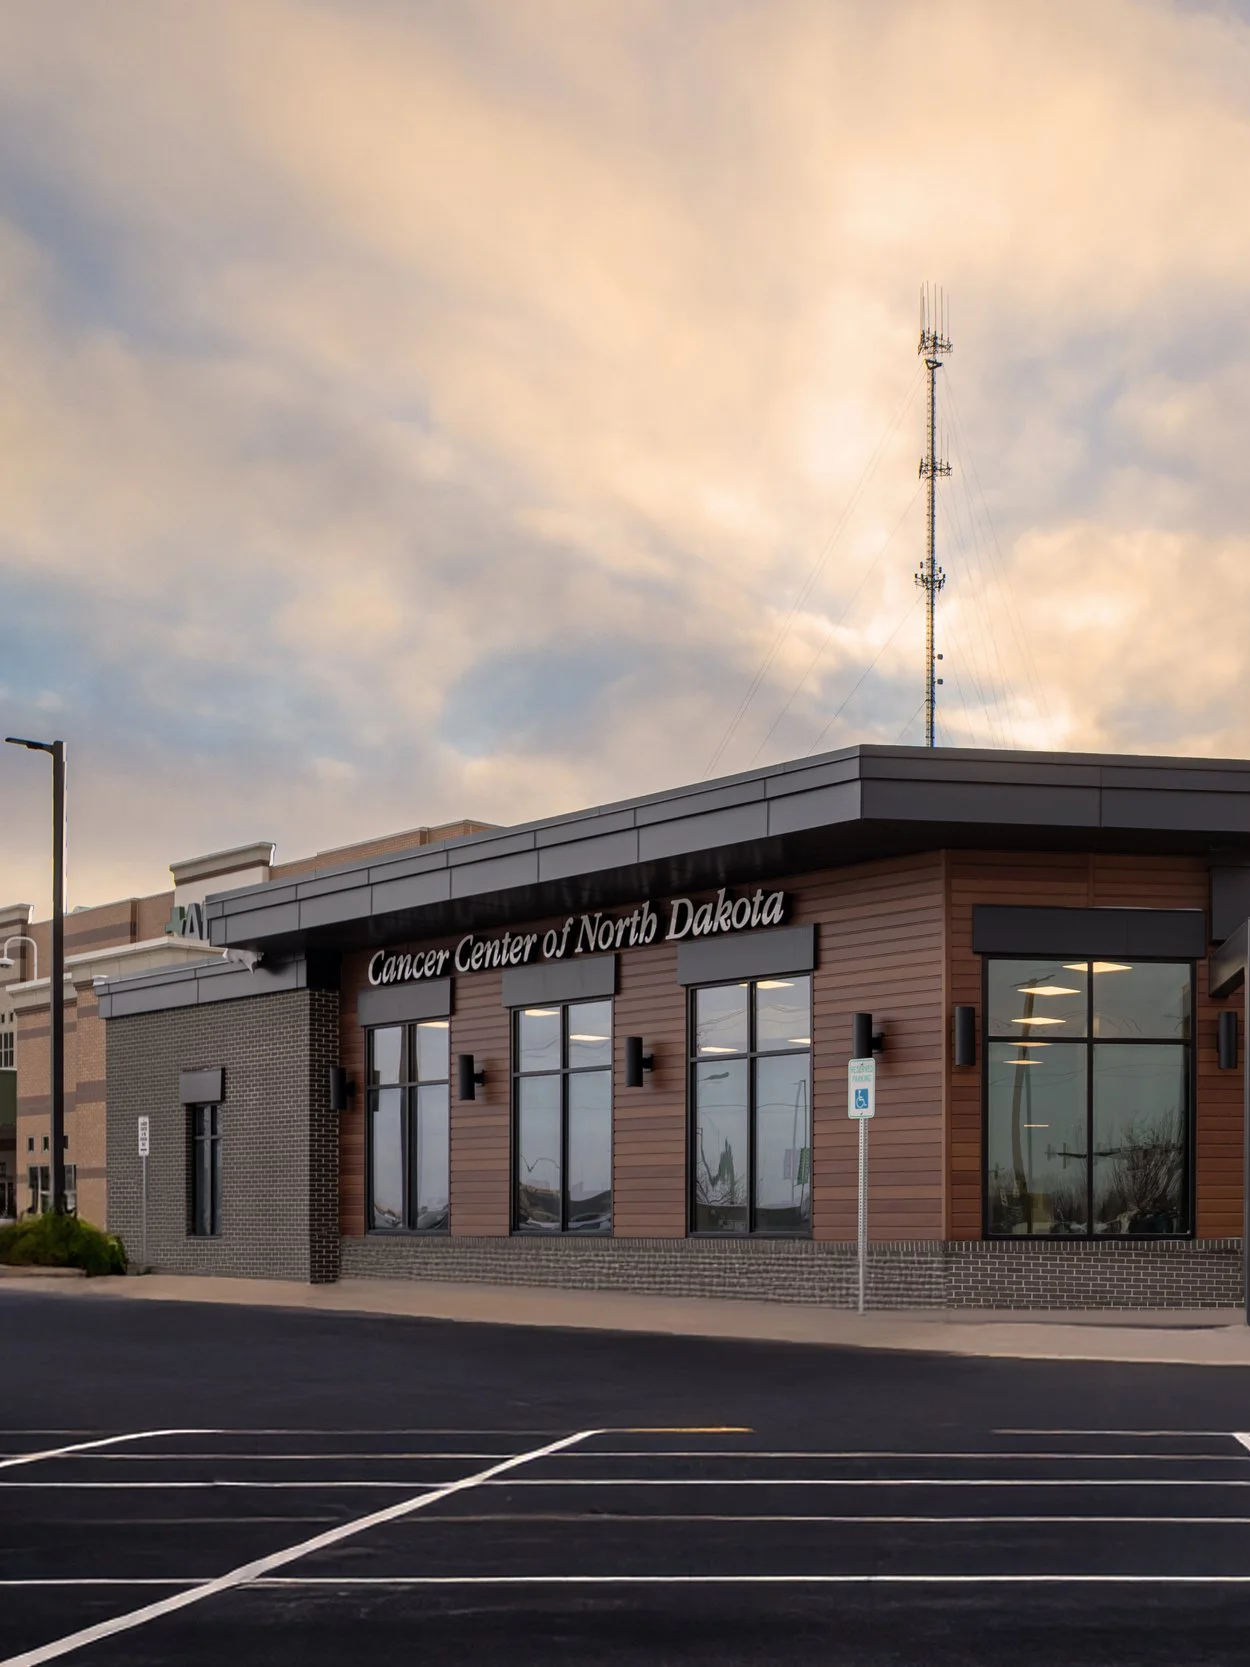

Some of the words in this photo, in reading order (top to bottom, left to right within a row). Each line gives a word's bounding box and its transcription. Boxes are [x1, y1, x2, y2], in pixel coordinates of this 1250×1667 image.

[368, 950, 450, 986] Cancer
[454, 934, 537, 973] Center
[543, 917, 574, 959] of
[574, 902, 658, 953] North
[665, 888, 785, 940] Dakota
